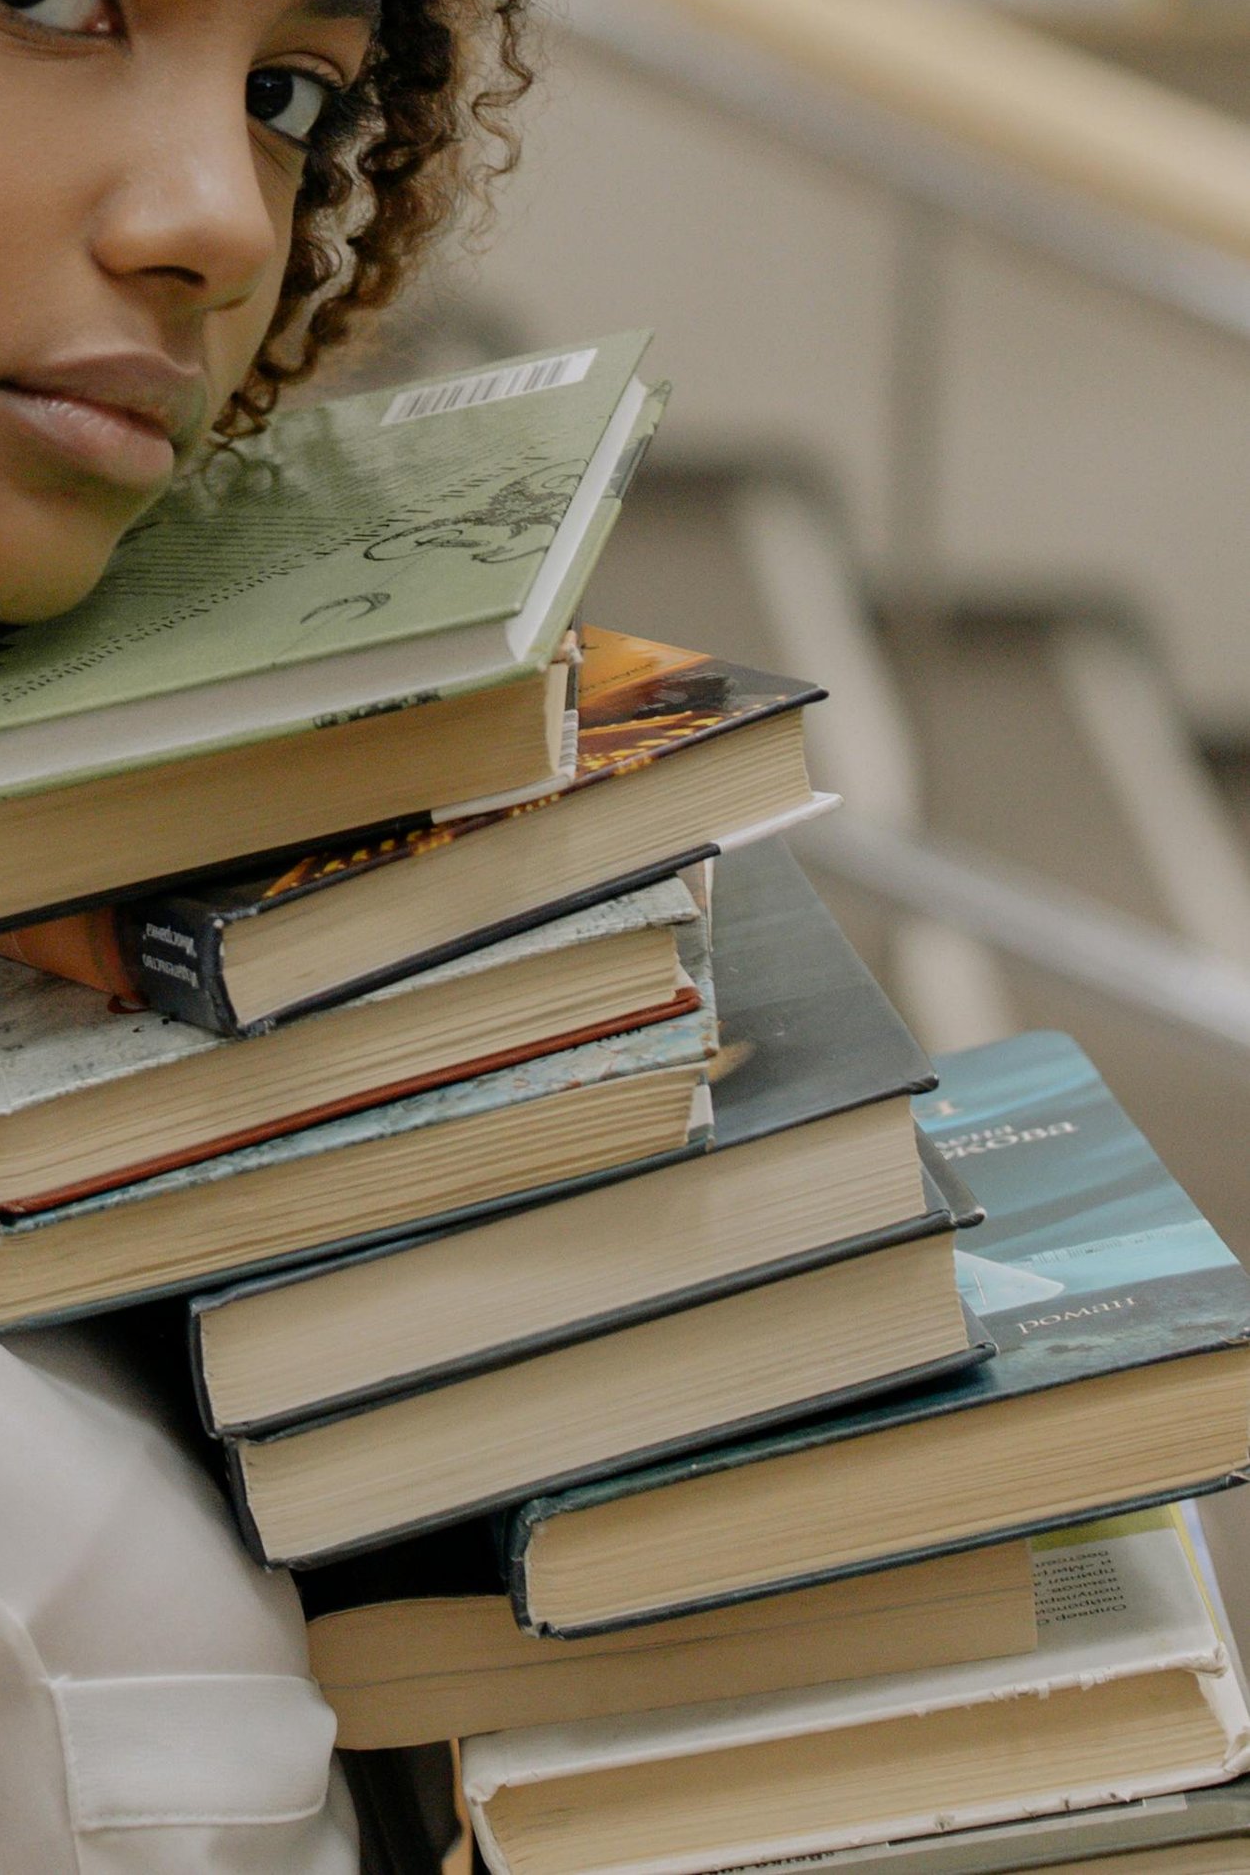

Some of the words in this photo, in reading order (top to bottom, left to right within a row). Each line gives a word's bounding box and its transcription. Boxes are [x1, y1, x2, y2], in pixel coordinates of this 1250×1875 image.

[425, 456, 548, 503] Frank
[312, 507, 433, 561] Heller
[209, 562, 307, 604] Marco
[129, 606, 210, 643] Polos
[1017, 1296, 1136, 1335] роман
[1055, 1604, 1127, 1622] Оливер
